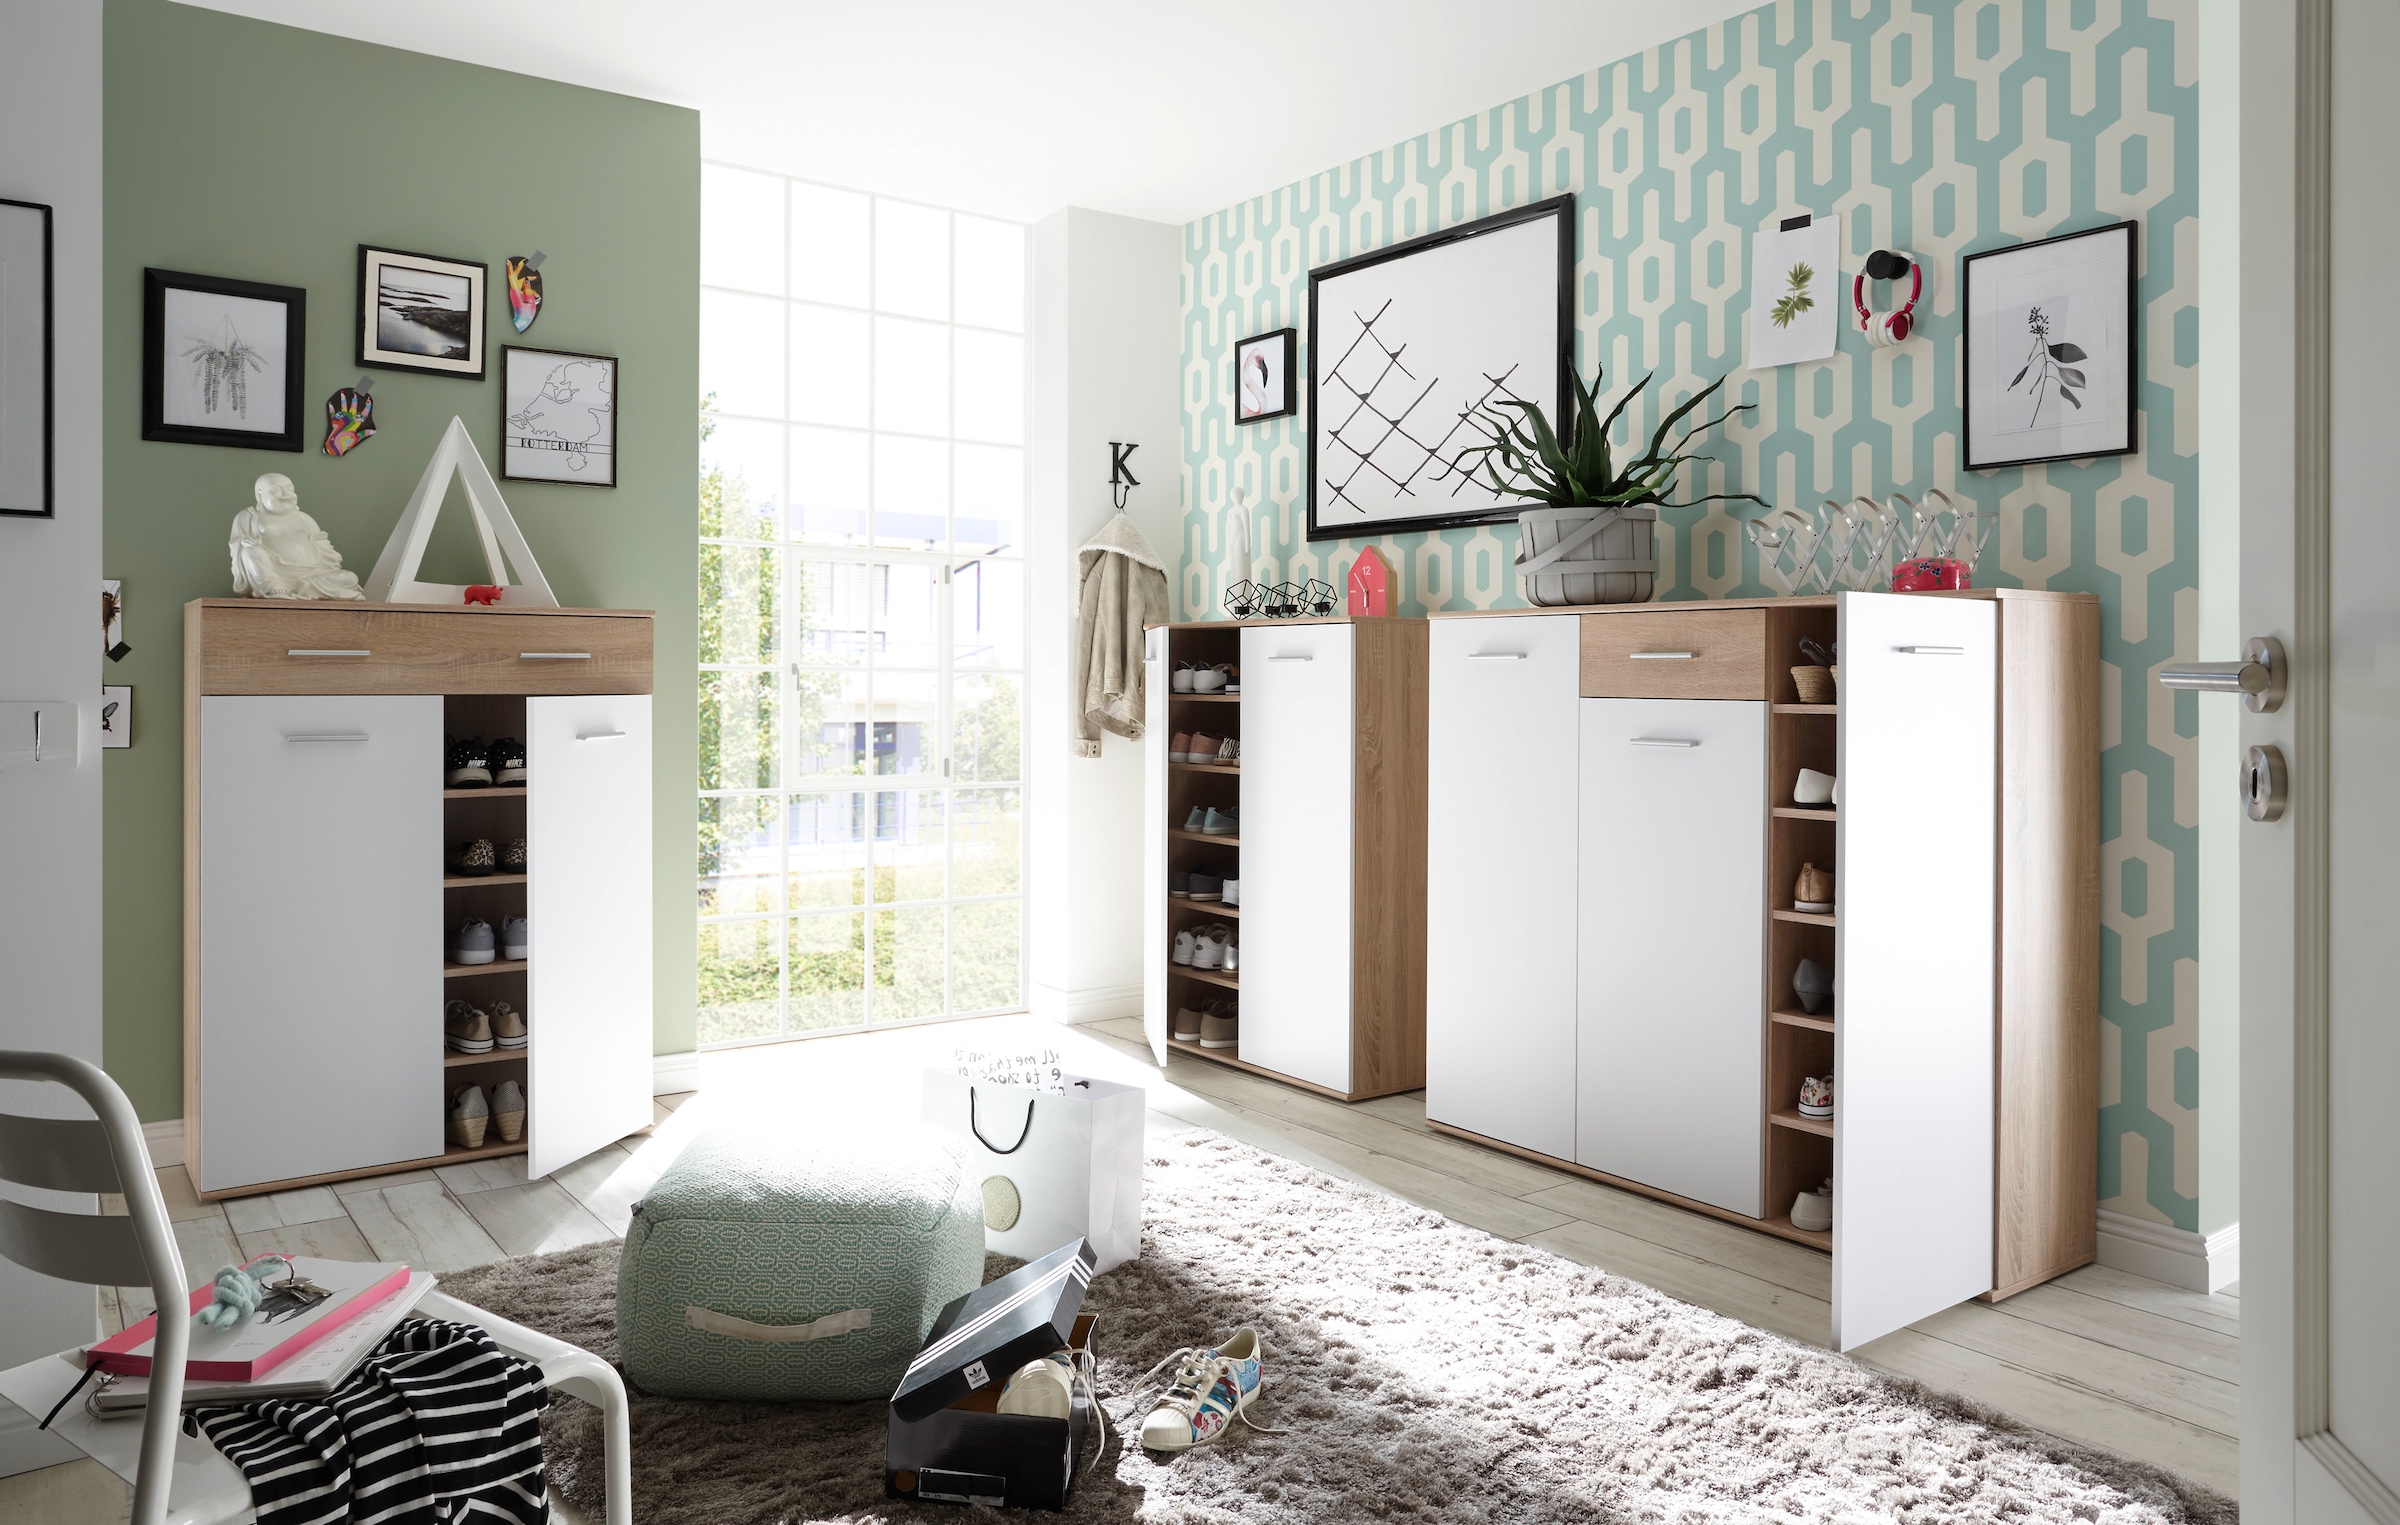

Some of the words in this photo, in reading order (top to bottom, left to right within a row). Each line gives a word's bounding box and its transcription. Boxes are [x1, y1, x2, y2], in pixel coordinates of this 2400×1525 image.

[521, 437, 588, 453] ROTTERDAM
[1108, 442, 1141, 485] K
[1362, 565, 1371, 576] 12
[467, 759, 487, 769] NIKE
[505, 758, 524, 769] NIKE
